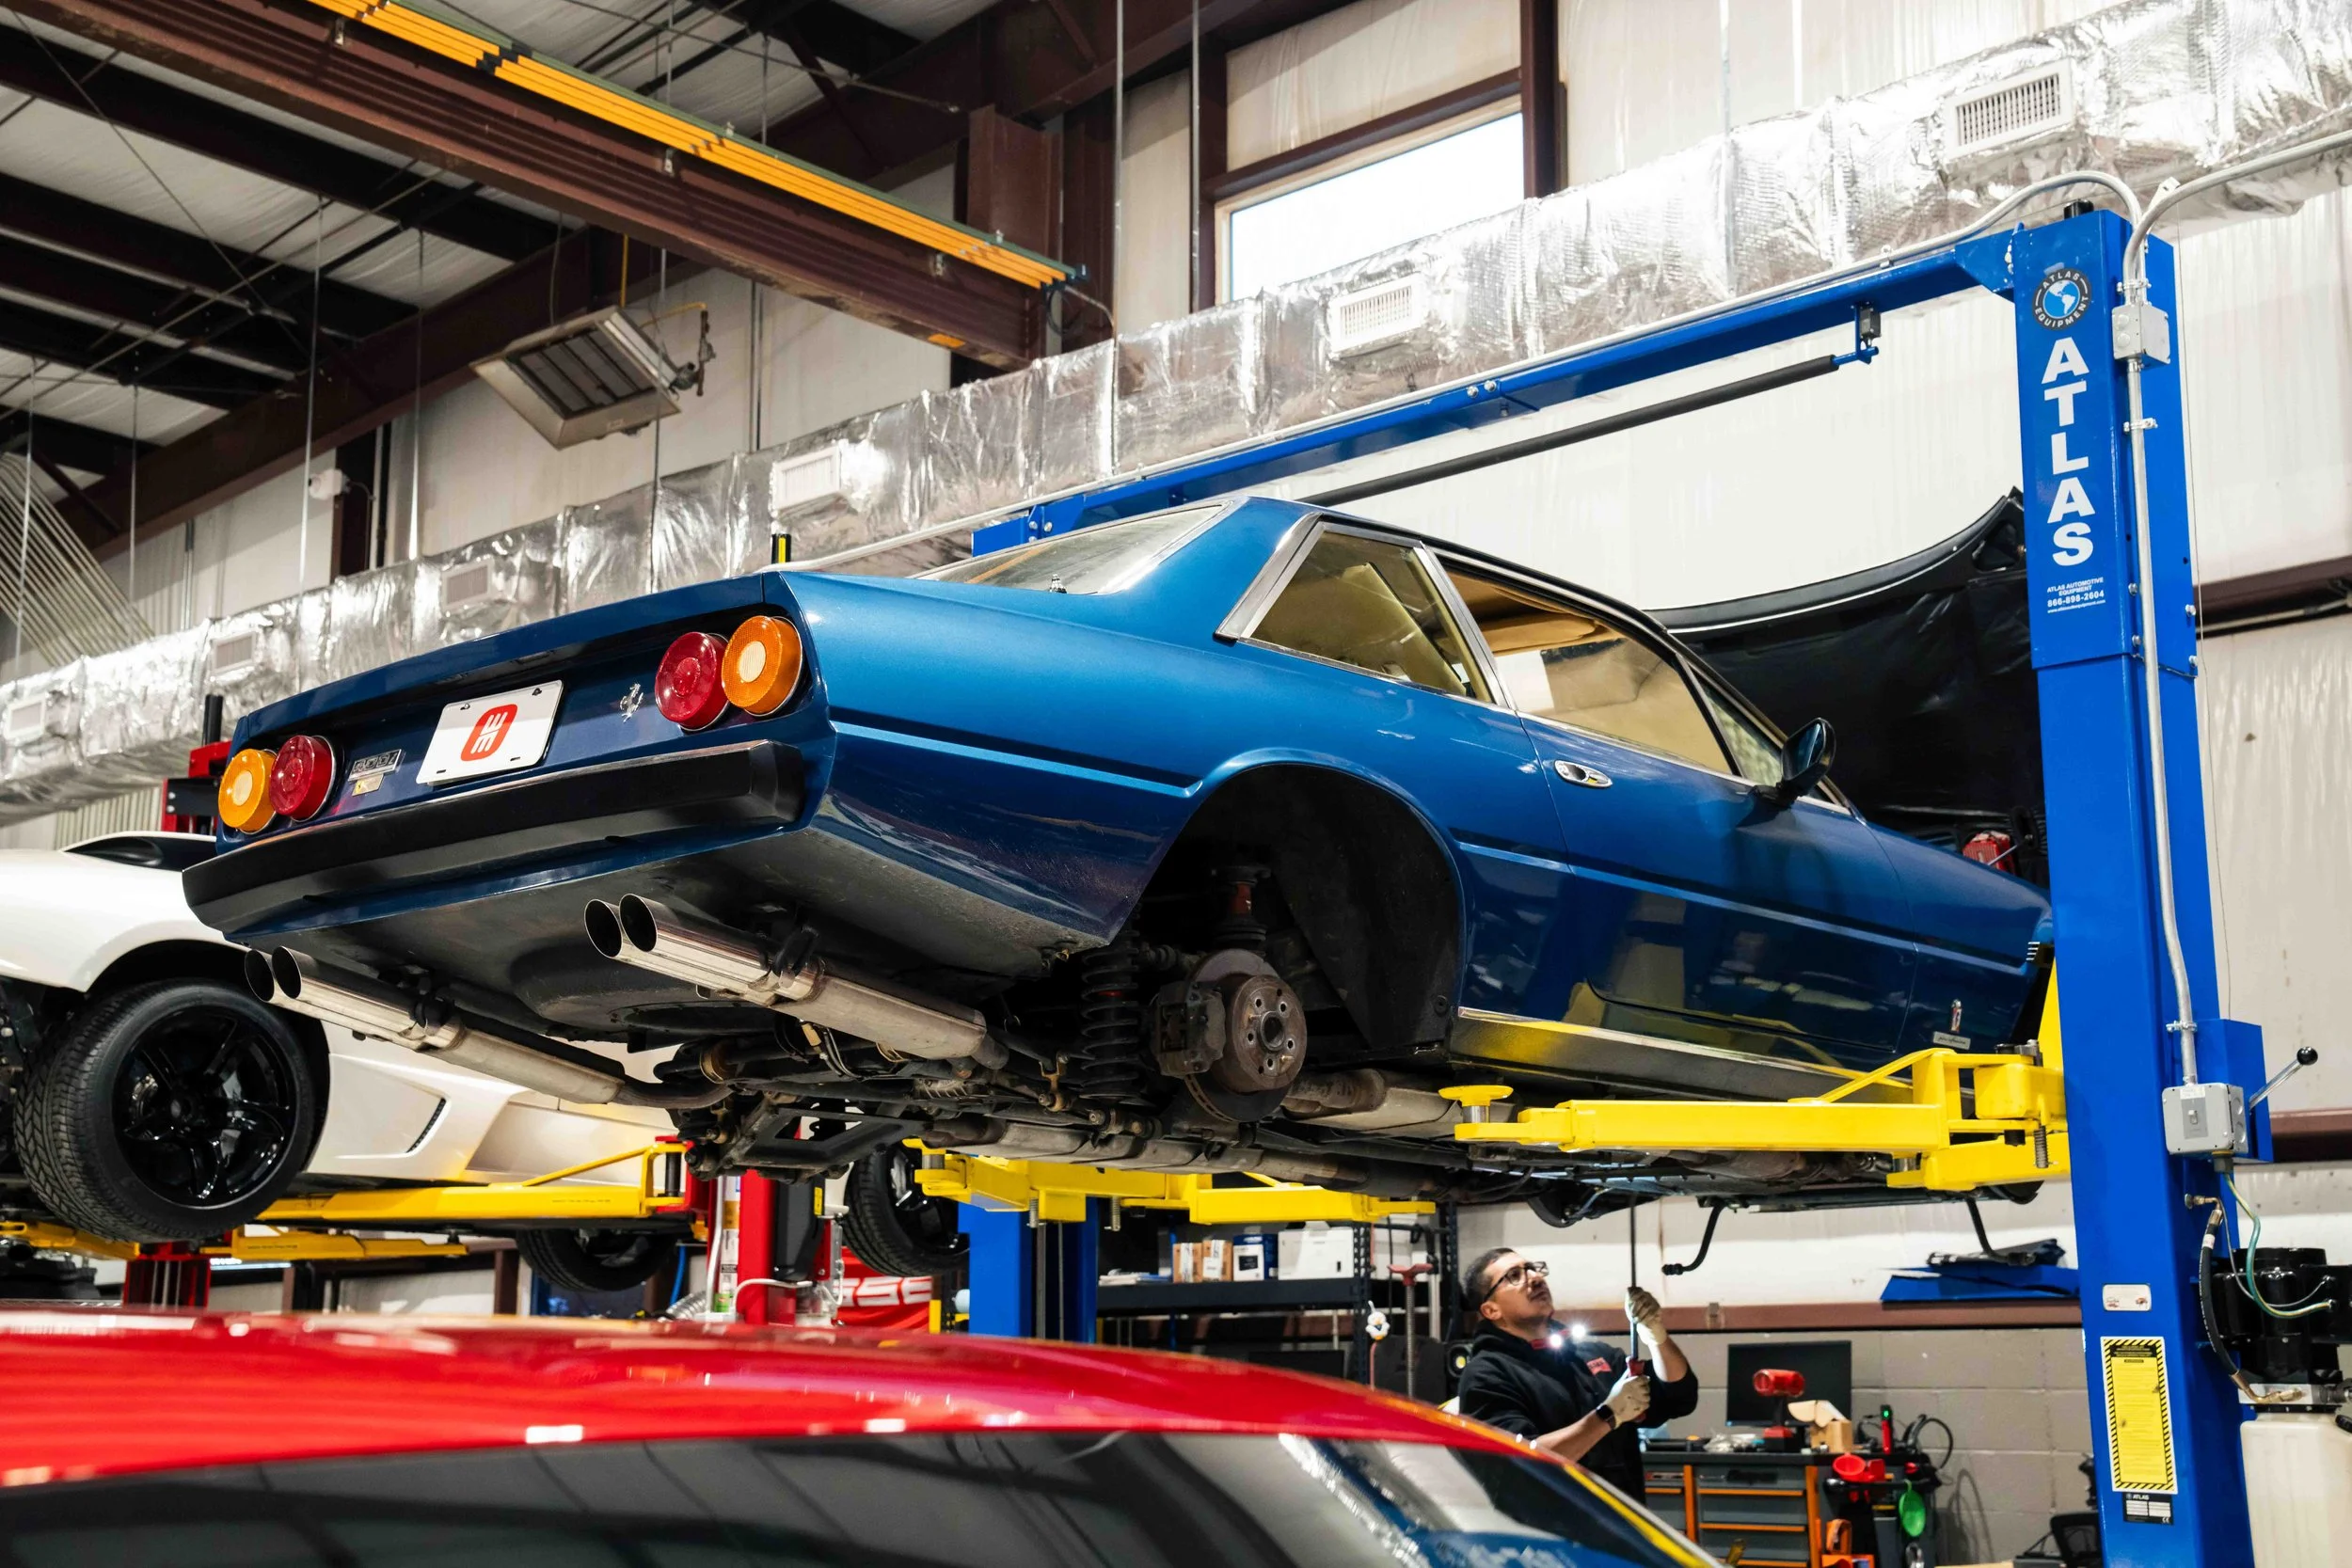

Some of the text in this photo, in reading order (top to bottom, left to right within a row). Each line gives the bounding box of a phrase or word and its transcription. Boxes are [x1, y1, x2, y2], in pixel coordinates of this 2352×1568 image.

[2042, 270, 2080, 289] ATLAS
[2035, 295, 2089, 327] EQUIPMENT
[2041, 337, 2095, 566] ATLAS
[2047, 577, 2104, 593] ATLAS AUTOMOTIVE
[2058, 585, 2092, 596] EQUIPMENT
[2047, 590, 2105, 608] 866-898-2604
